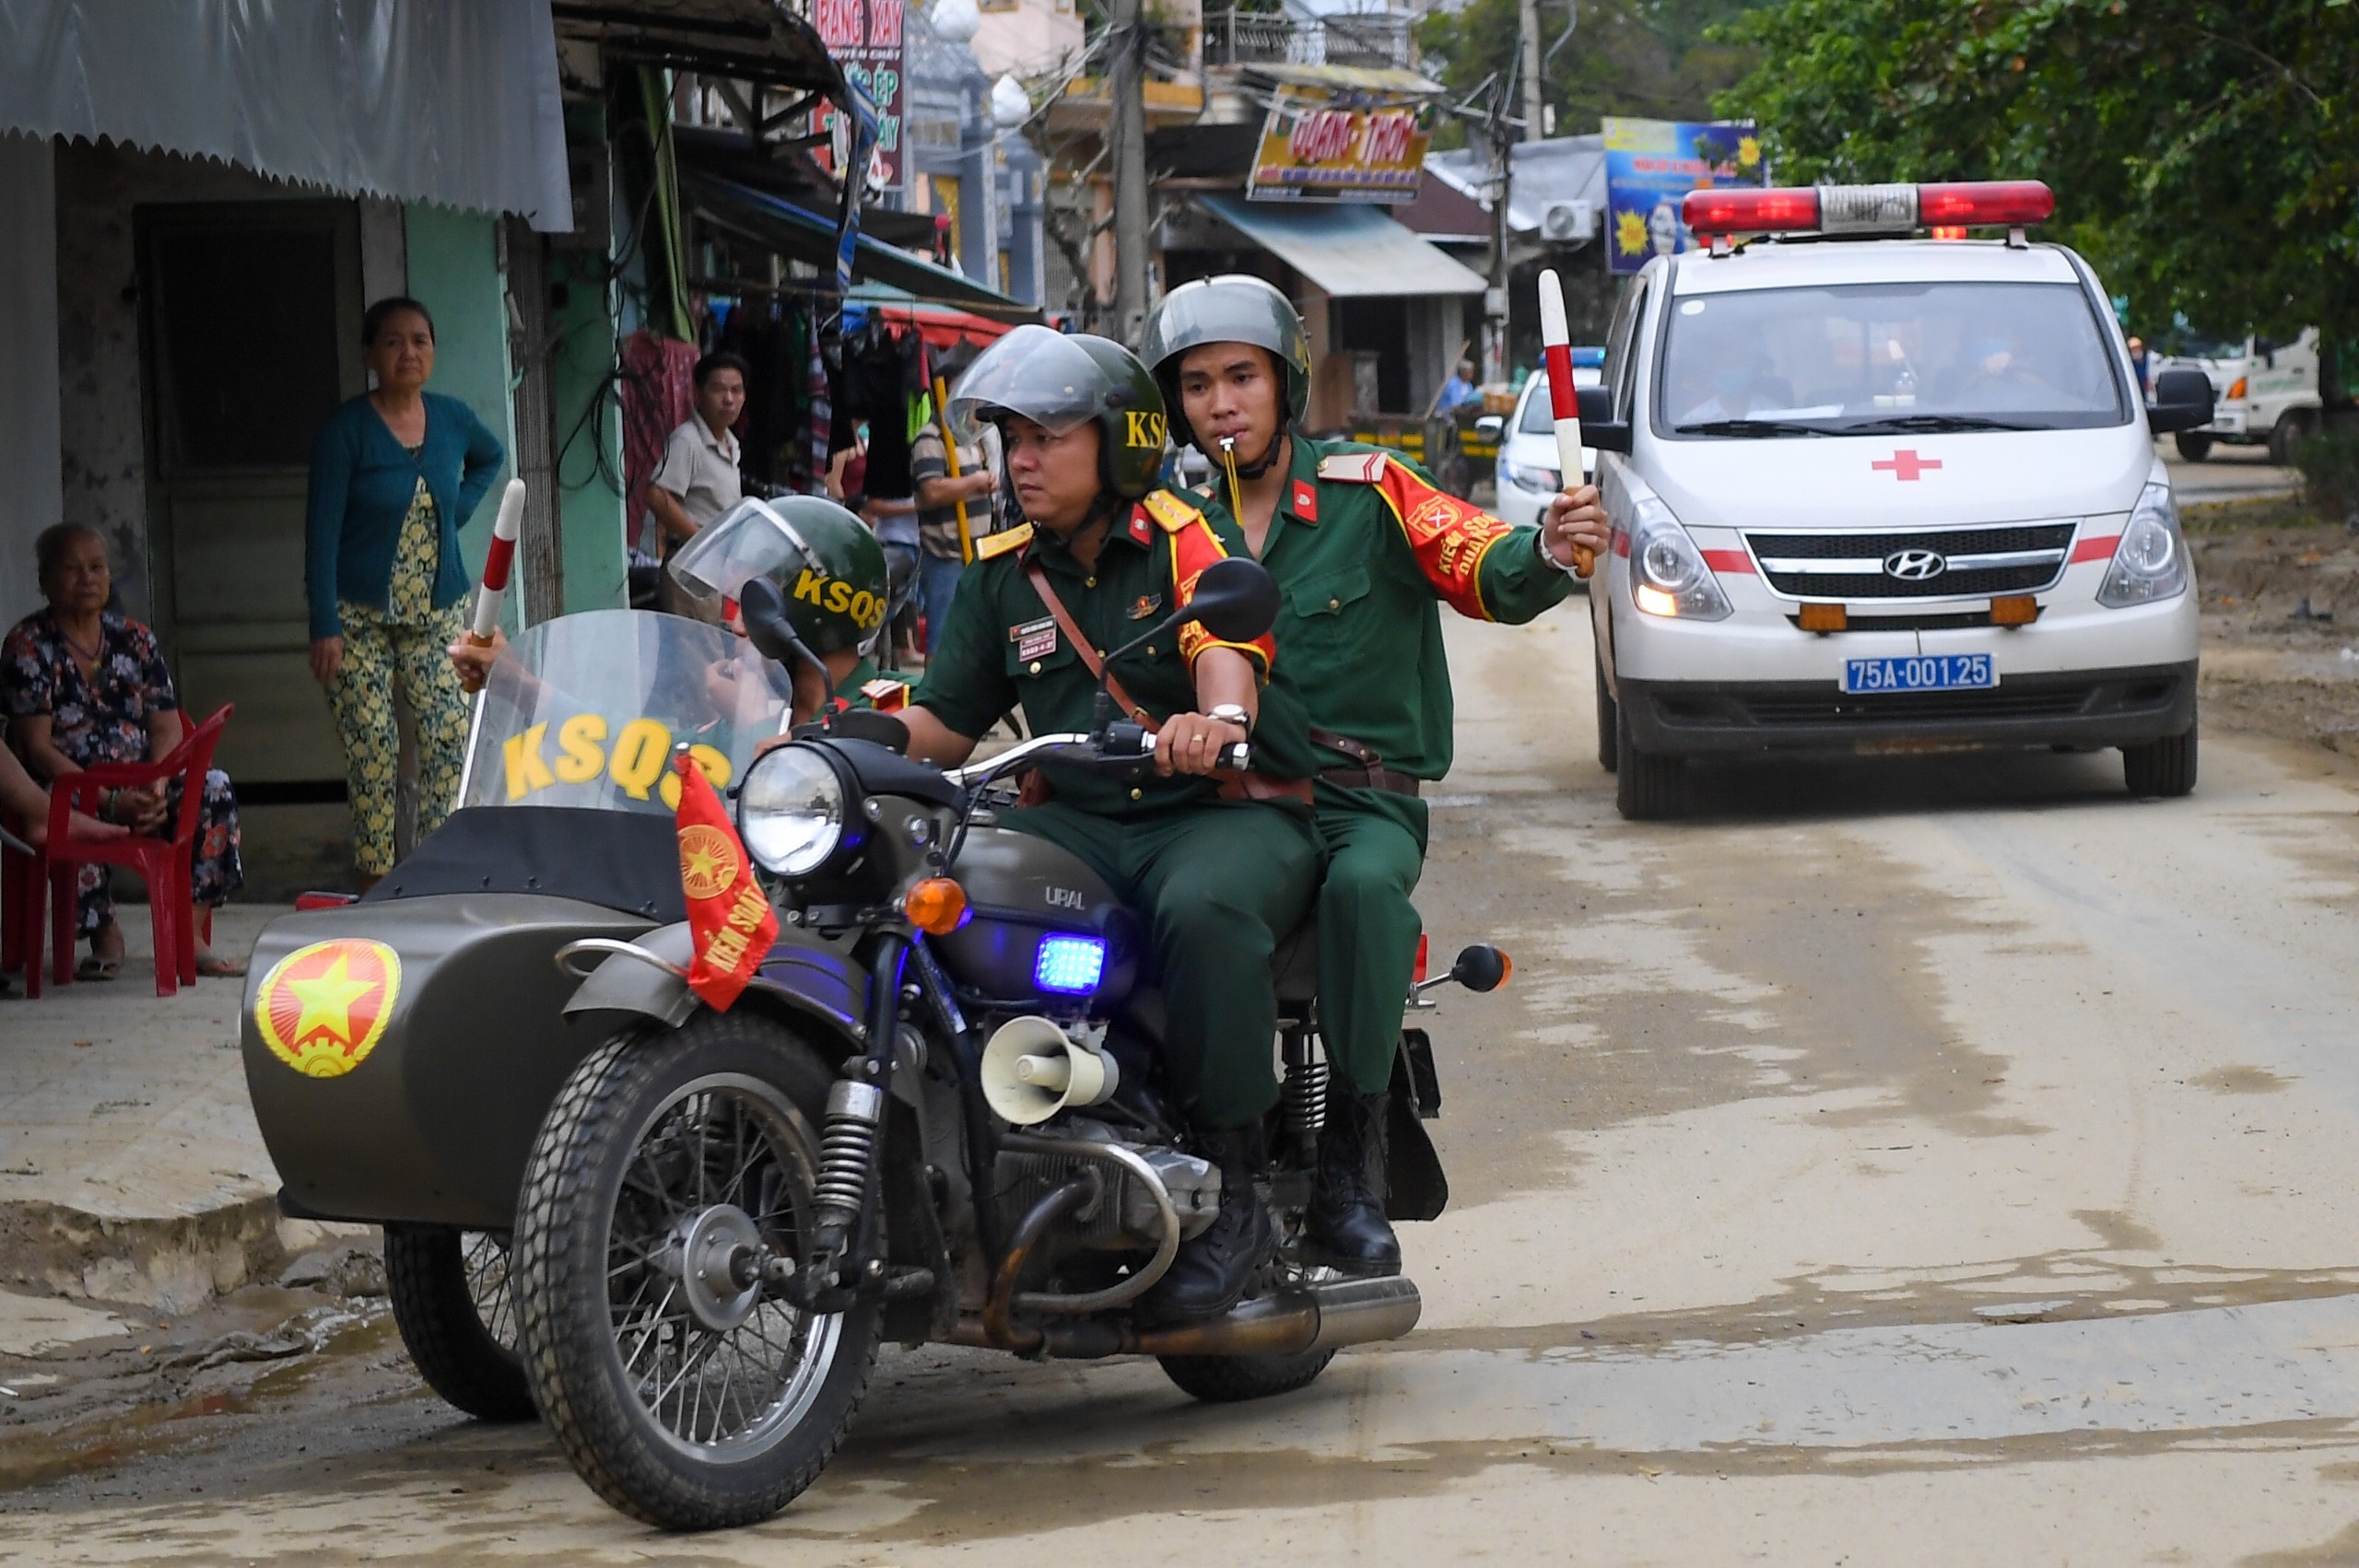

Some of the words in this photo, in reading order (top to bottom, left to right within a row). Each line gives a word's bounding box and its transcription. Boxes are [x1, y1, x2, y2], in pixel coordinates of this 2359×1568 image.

[816, 0, 864, 46] RANG
[869, 0, 904, 47] XAY
[794, 568, 886, 628] KSQS
[503, 714, 733, 812] KSQS
[727, 885, 769, 933] SOÁT
[1045, 886, 1086, 910] URAL
